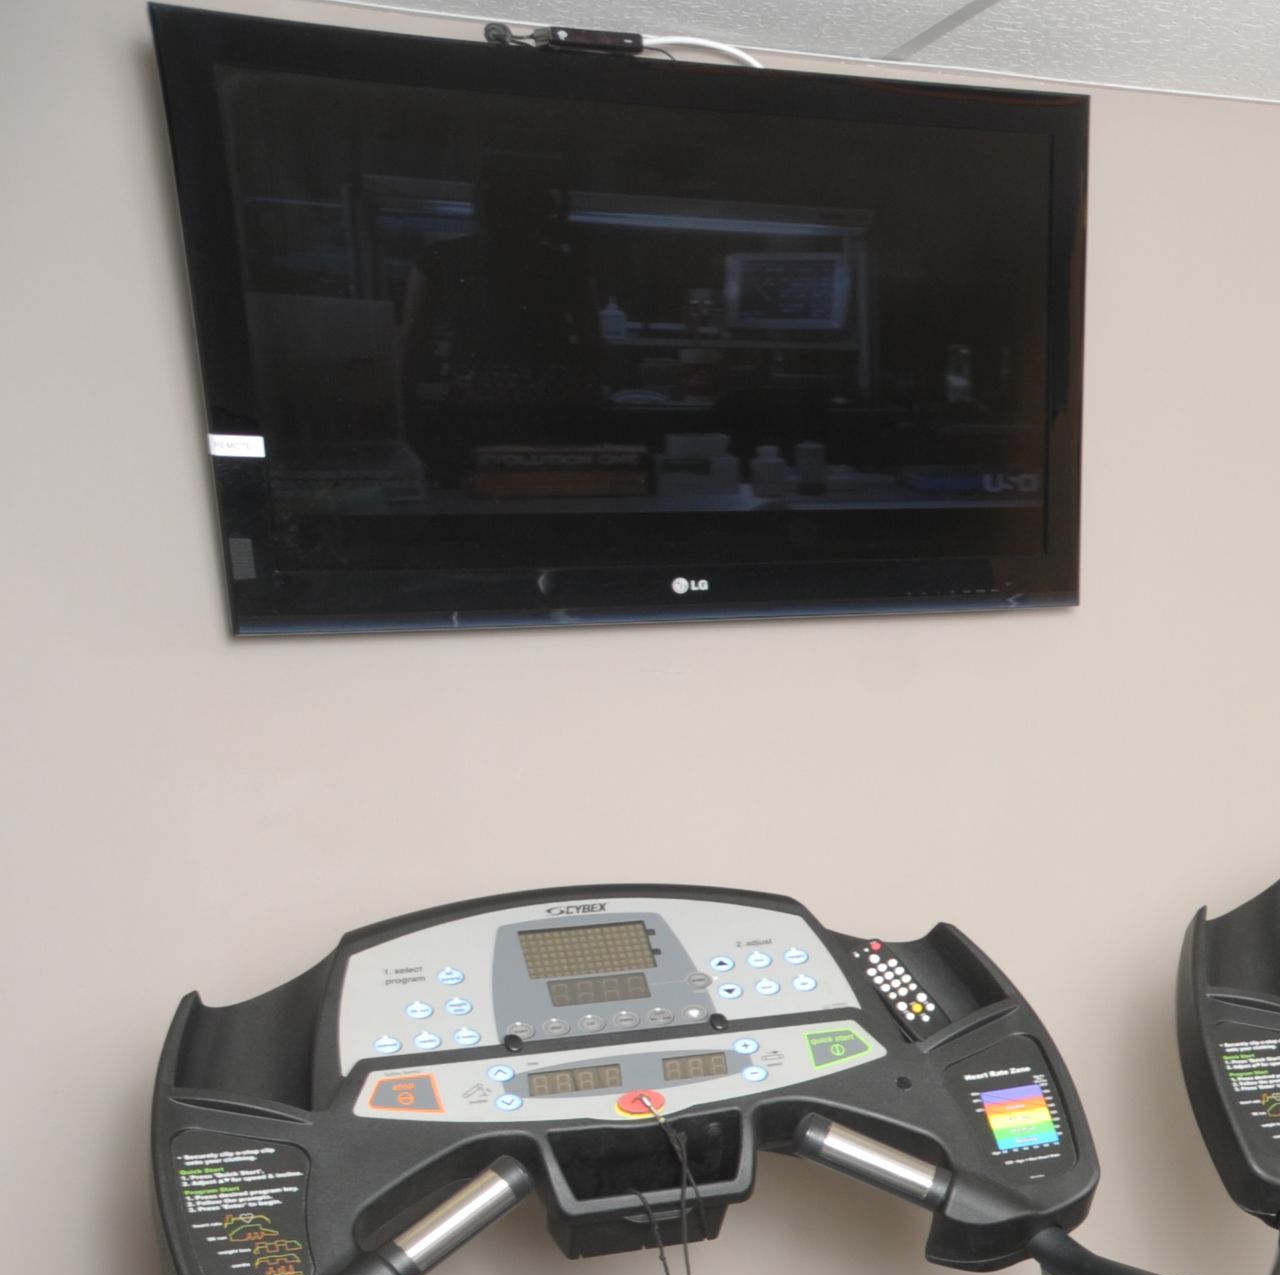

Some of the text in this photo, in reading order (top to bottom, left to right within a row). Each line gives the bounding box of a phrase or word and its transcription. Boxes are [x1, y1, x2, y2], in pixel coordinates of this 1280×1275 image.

[691, 579, 709, 590] LG
[565, 902, 608, 915] CYBEX
[385, 974, 426, 986] program
[963, 1066, 1031, 1081] Heart Rate Zone
